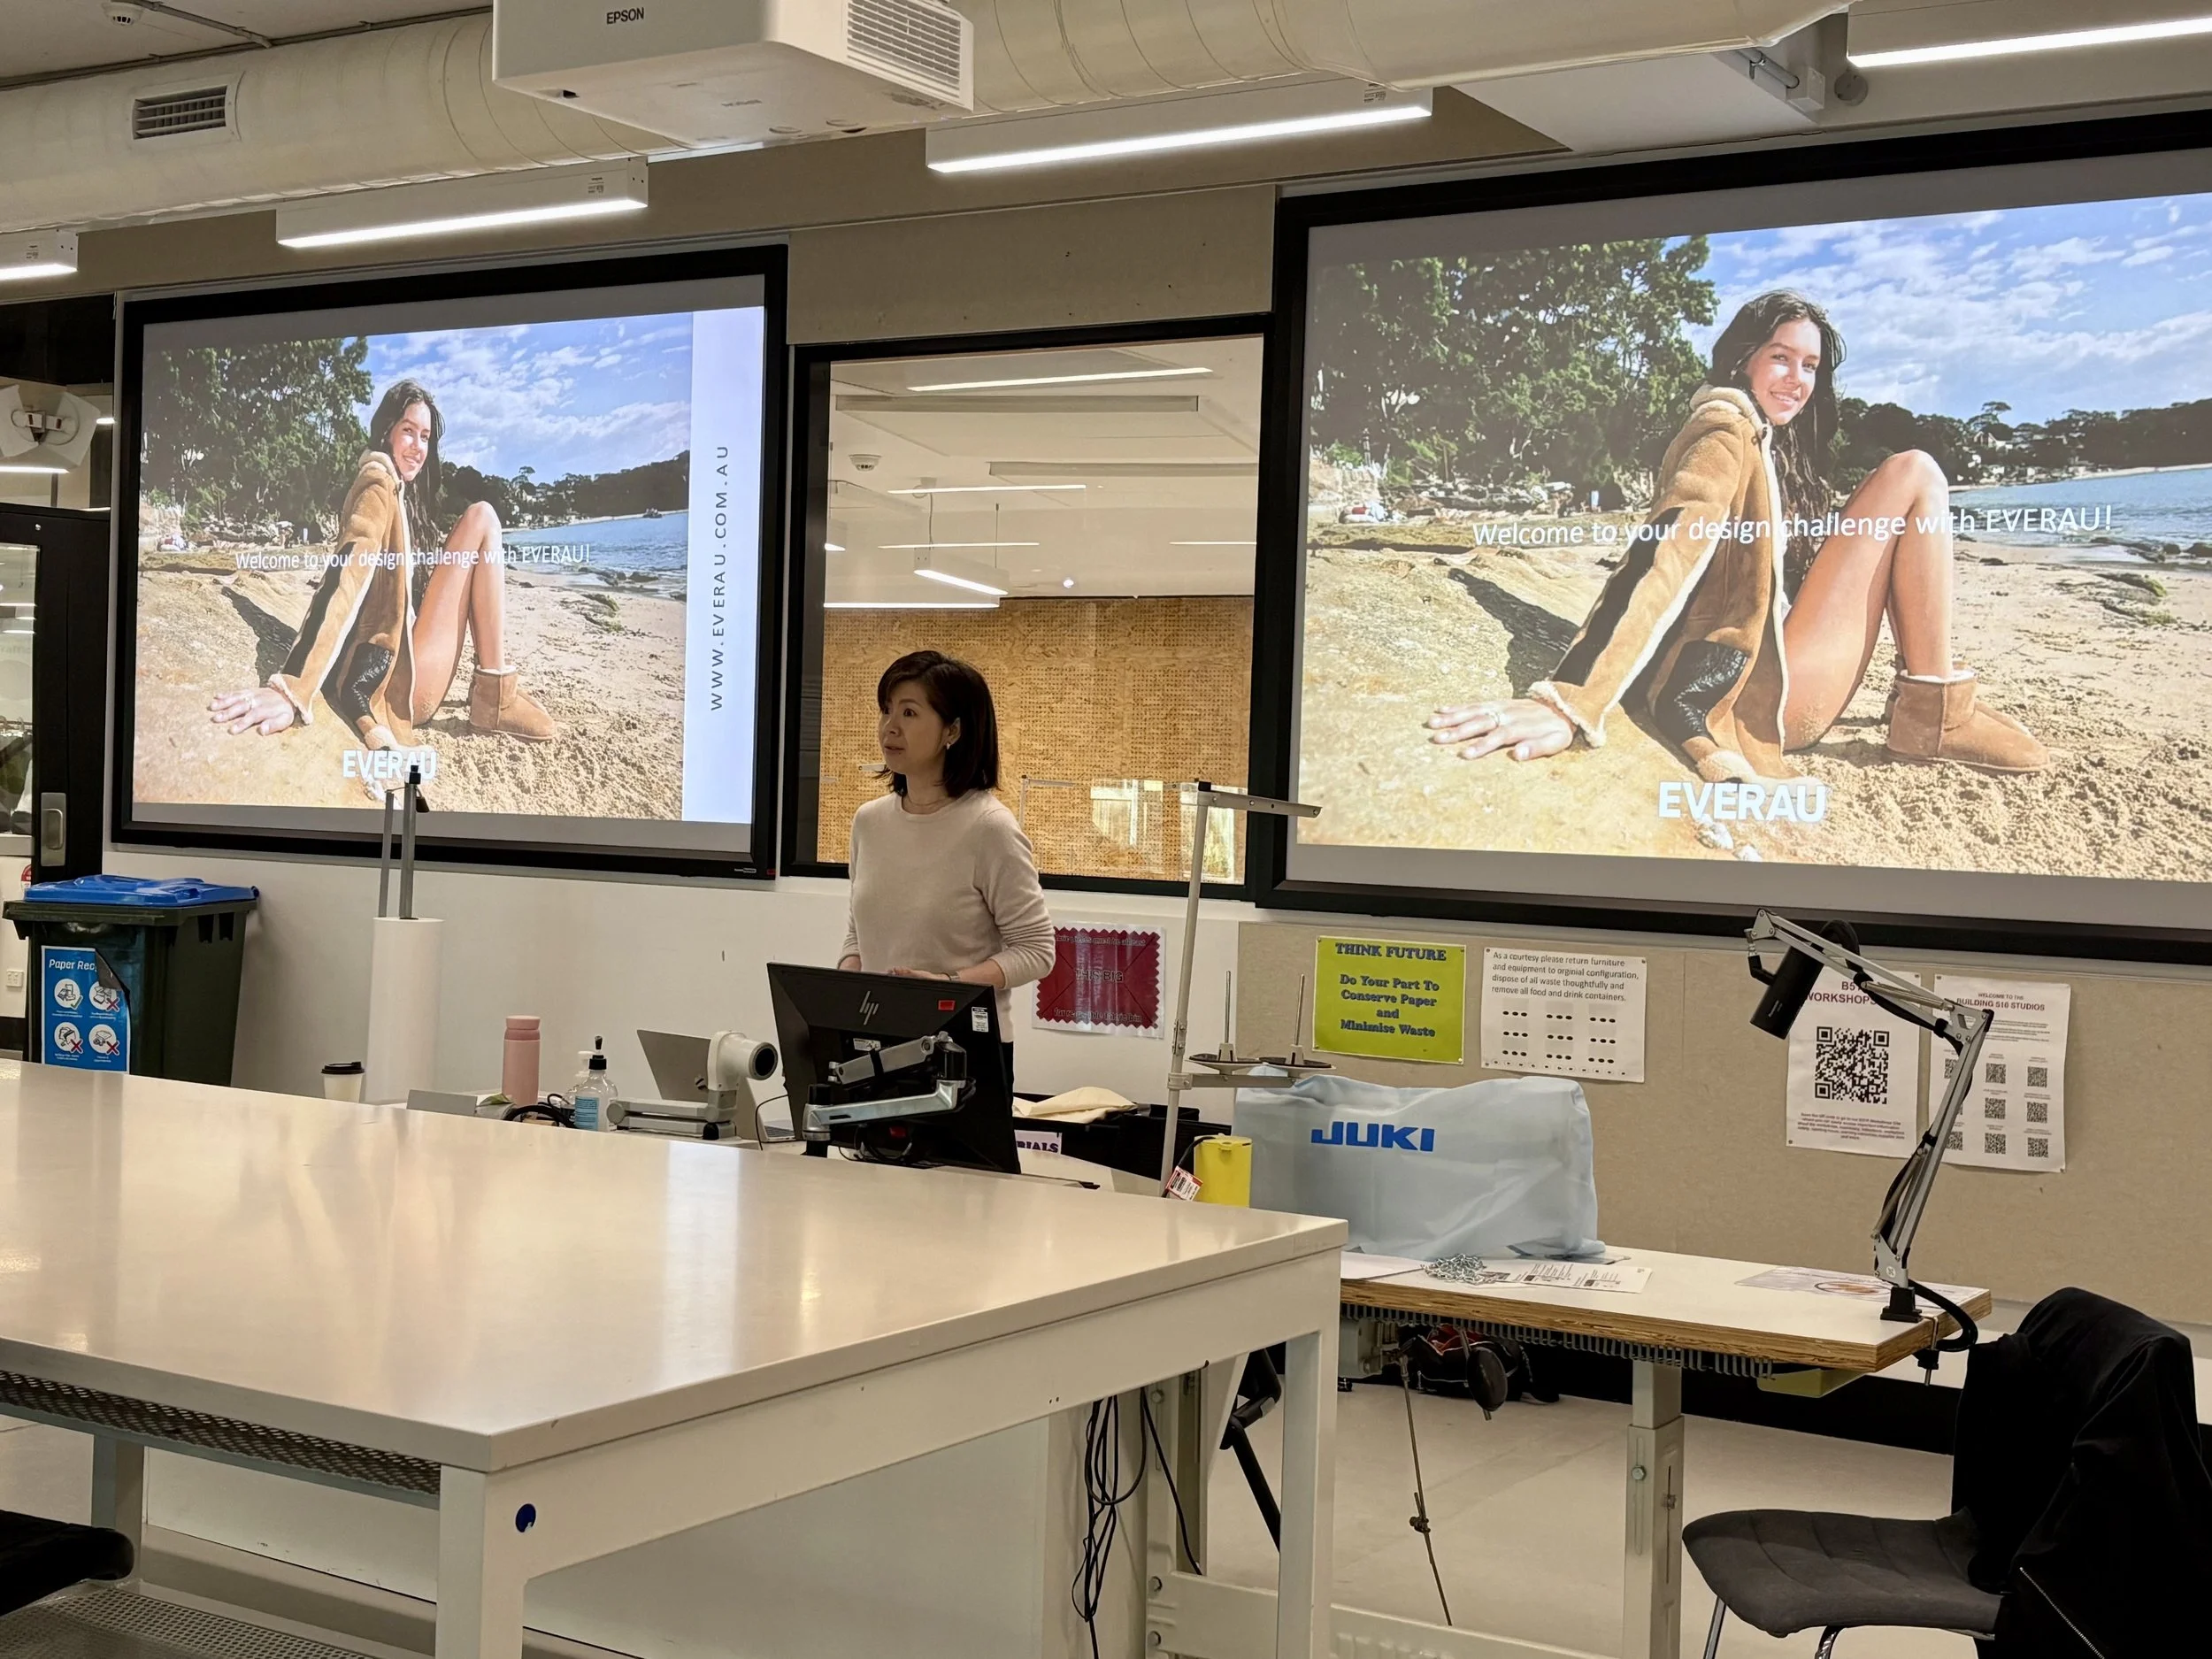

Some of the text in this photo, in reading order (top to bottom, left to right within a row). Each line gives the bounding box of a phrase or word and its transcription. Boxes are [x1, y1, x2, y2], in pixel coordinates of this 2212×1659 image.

[606, 7, 644, 25] EPSON
[1472, 504, 2111, 548] Welcome to your design challenge with EVERAU!
[235, 543, 590, 572] Welcome to your design challenge with EVERAU!
[343, 749, 438, 780] EVERAU
[1658, 780, 1827, 823] EVERAU
[1335, 942, 1447, 962] THINK FUTURE
[1509, 953, 1540, 964] courtesy
[1540, 955, 1564, 964] please
[1565, 956, 1589, 965] return
[1591, 956, 1625, 967] furniture
[49, 958, 76, 971] Paper
[1508, 964, 1546, 974] equipment
[1102, 971, 1124, 982] BIG
[1340, 974, 1440, 992] Do Your Part To
[1492, 974, 1519, 985] dispose
[1563, 979, 1609, 990] thoughtfully
[1530, 987, 1547, 996] food
[1563, 990, 1583, 999] drink
[1585, 992, 1626, 1002] containers.
[1841, 981, 1862, 991] B5
[1341, 989, 1438, 1008] Conserve Paper
[1956, 998, 1993, 1008] BUILDING
[2011, 1001, 2046, 1011] STUDIOS
[1376, 1009, 1400, 1019] and
[1340, 1019, 1436, 1037] Minimise Waste
[1310, 1121, 1435, 1152] JUKI
